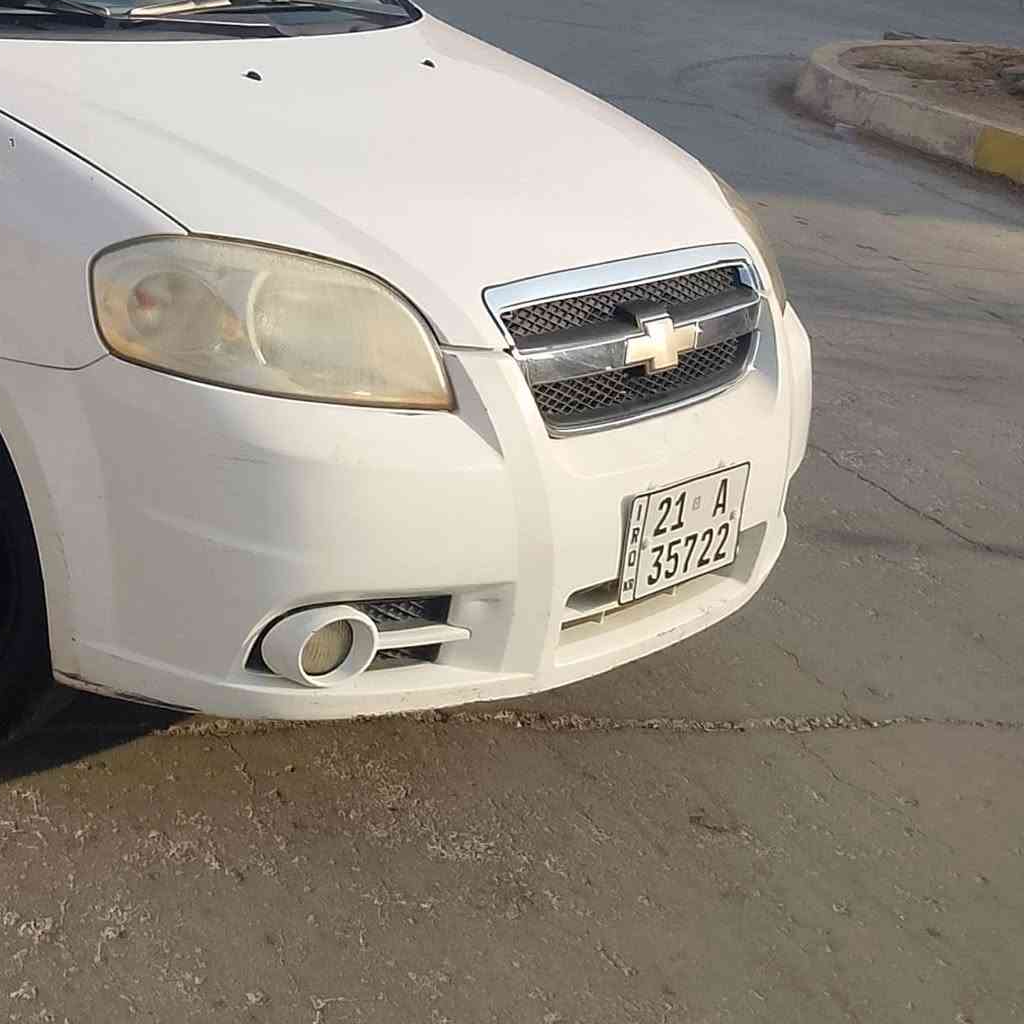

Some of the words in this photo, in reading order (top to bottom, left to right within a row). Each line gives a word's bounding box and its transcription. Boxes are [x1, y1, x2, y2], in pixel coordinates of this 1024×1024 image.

[653, 491, 687, 537] 21
[711, 478, 729, 518] A
[647, 523, 730, 586] 35722
